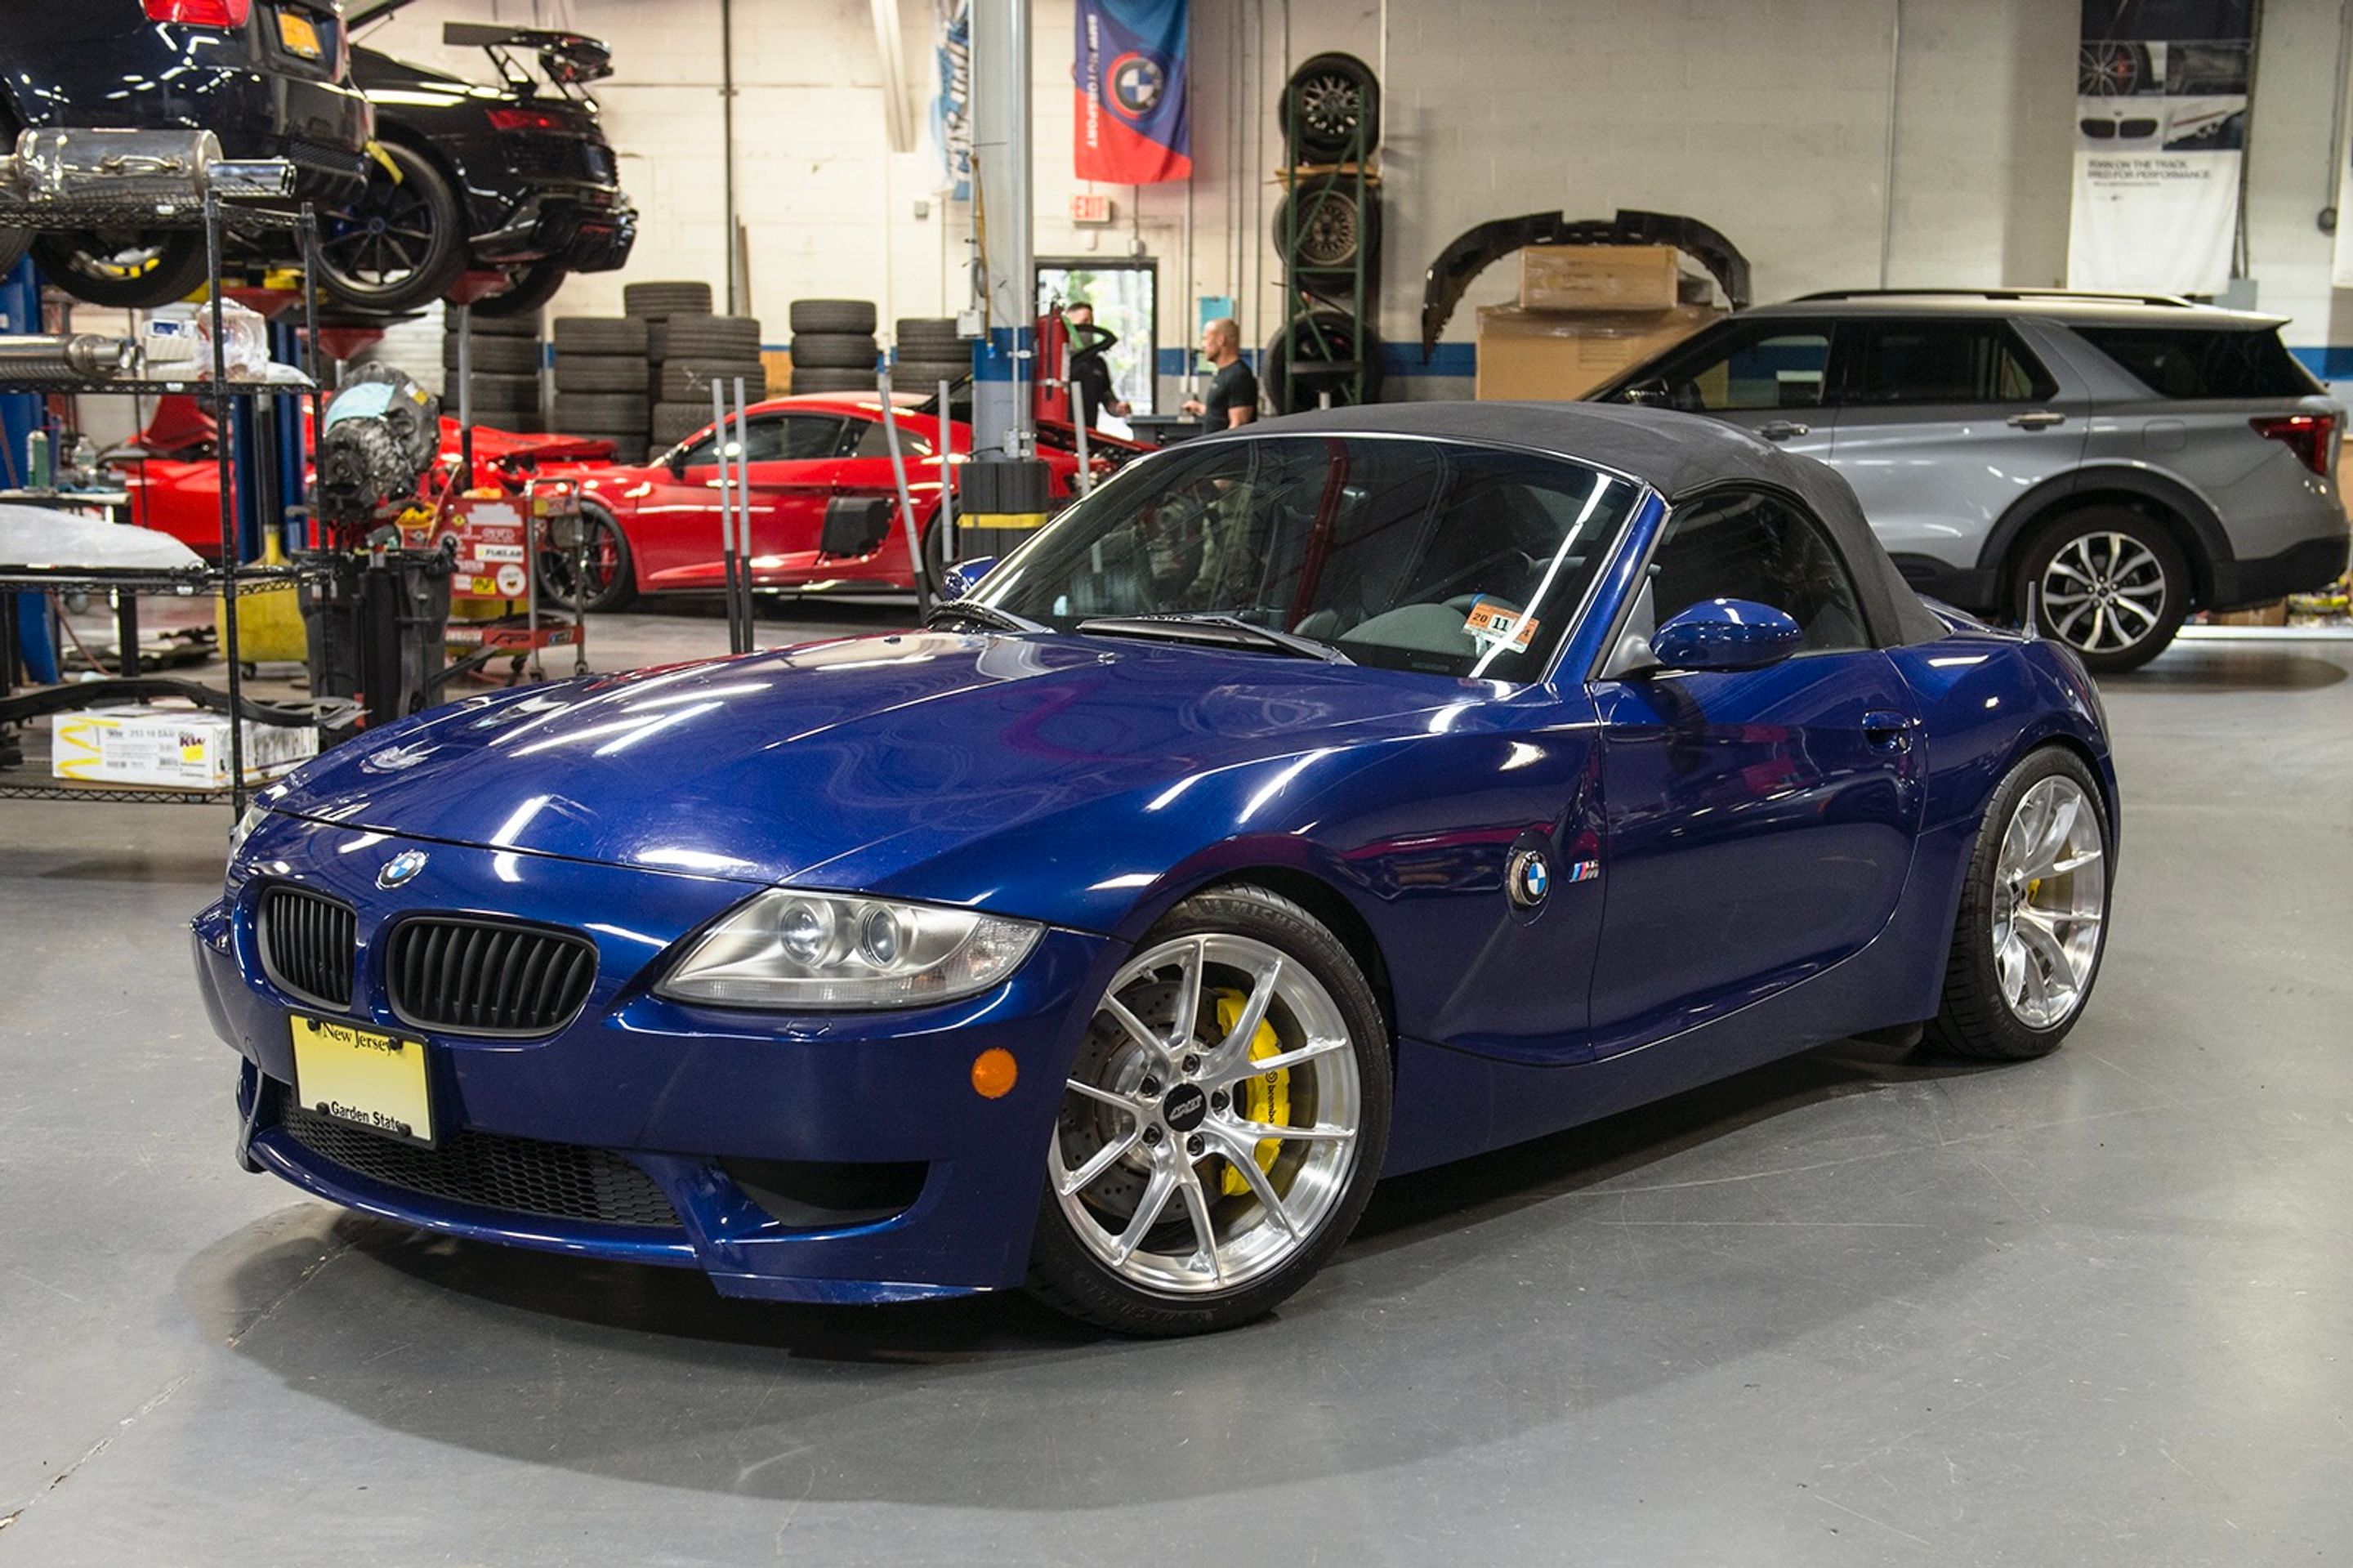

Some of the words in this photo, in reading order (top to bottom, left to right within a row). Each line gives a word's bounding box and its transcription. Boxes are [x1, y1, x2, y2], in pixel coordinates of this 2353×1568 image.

[1472, 613, 1489, 623] 20
[1492, 617, 1509, 632] 11
[323, 1021, 352, 1043] New
[330, 1100, 370, 1123] Garden
[1267, 1083, 1277, 1124] brembo
